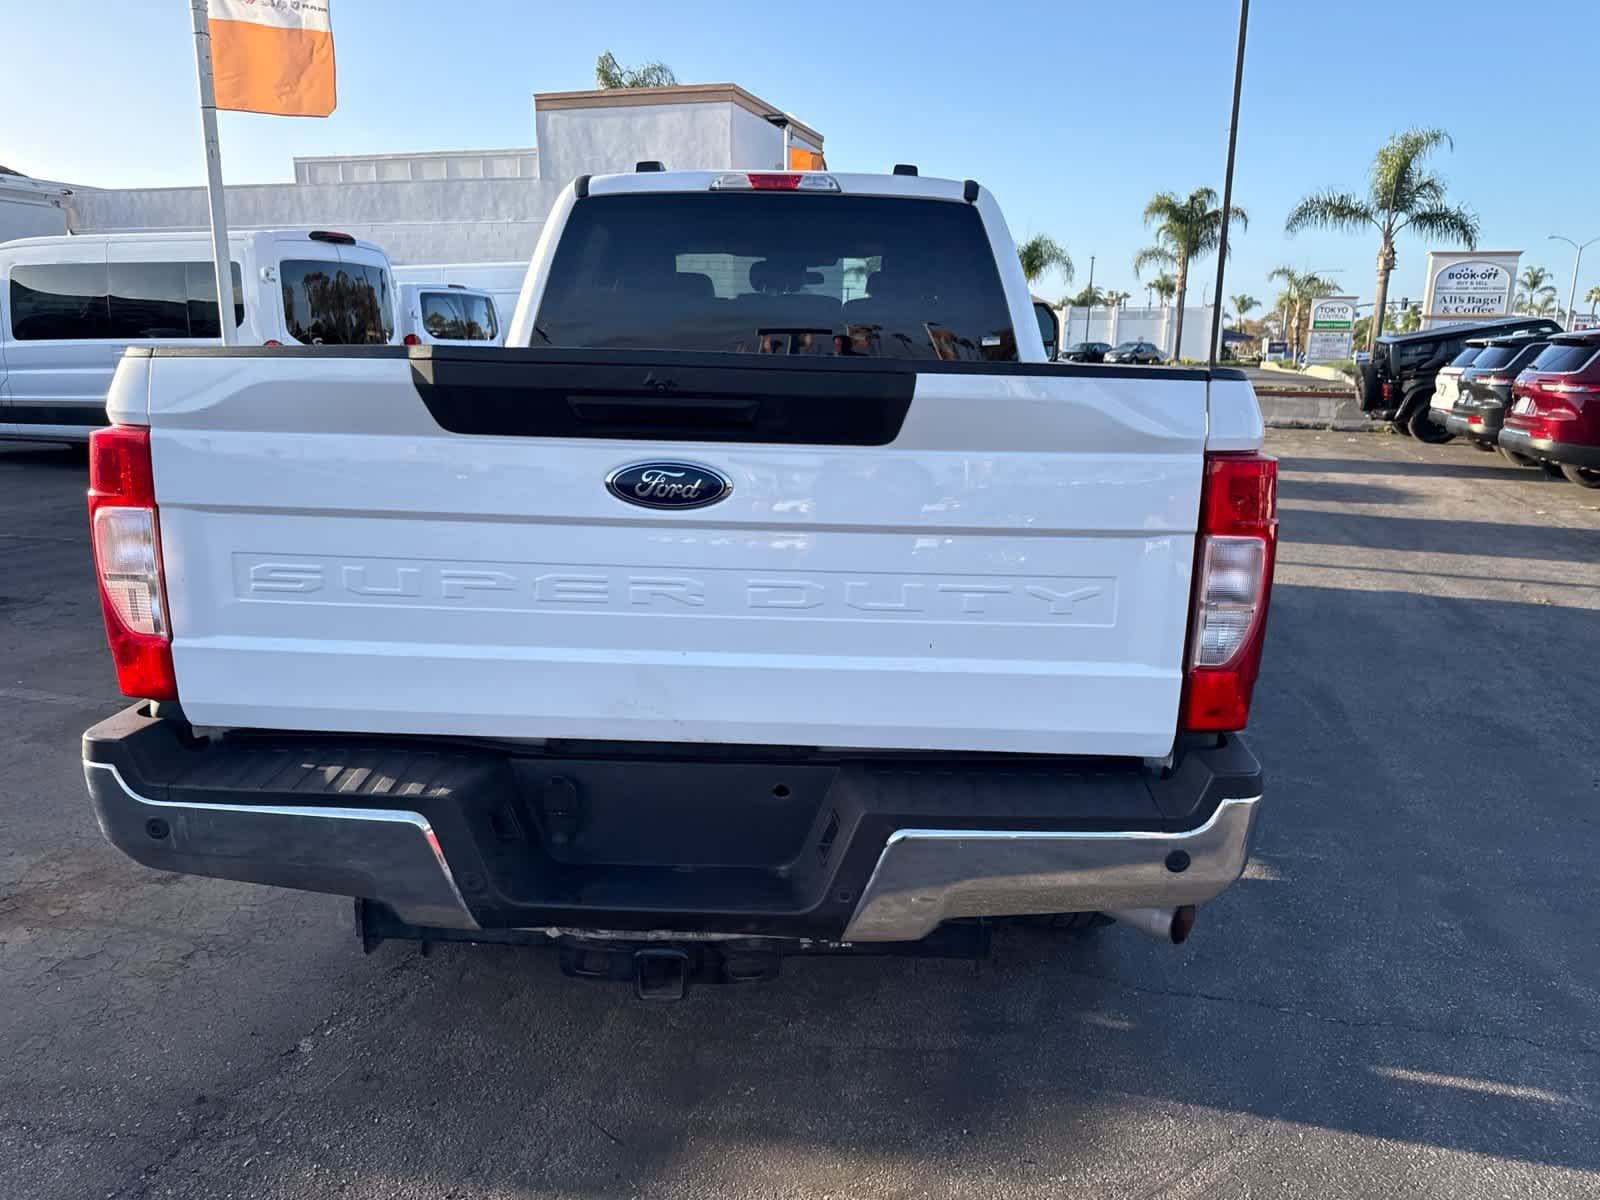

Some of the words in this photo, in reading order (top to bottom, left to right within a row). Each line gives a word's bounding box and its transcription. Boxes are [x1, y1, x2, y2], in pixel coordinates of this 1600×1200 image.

[1442, 305, 1450, 314] &
[1455, 305, 1495, 314] Coffee
[1467, 295, 1502, 306] Bagel
[635, 469, 702, 498] Ford
[249, 563, 704, 607] SUPER
[747, 579, 1102, 614] DUTY
